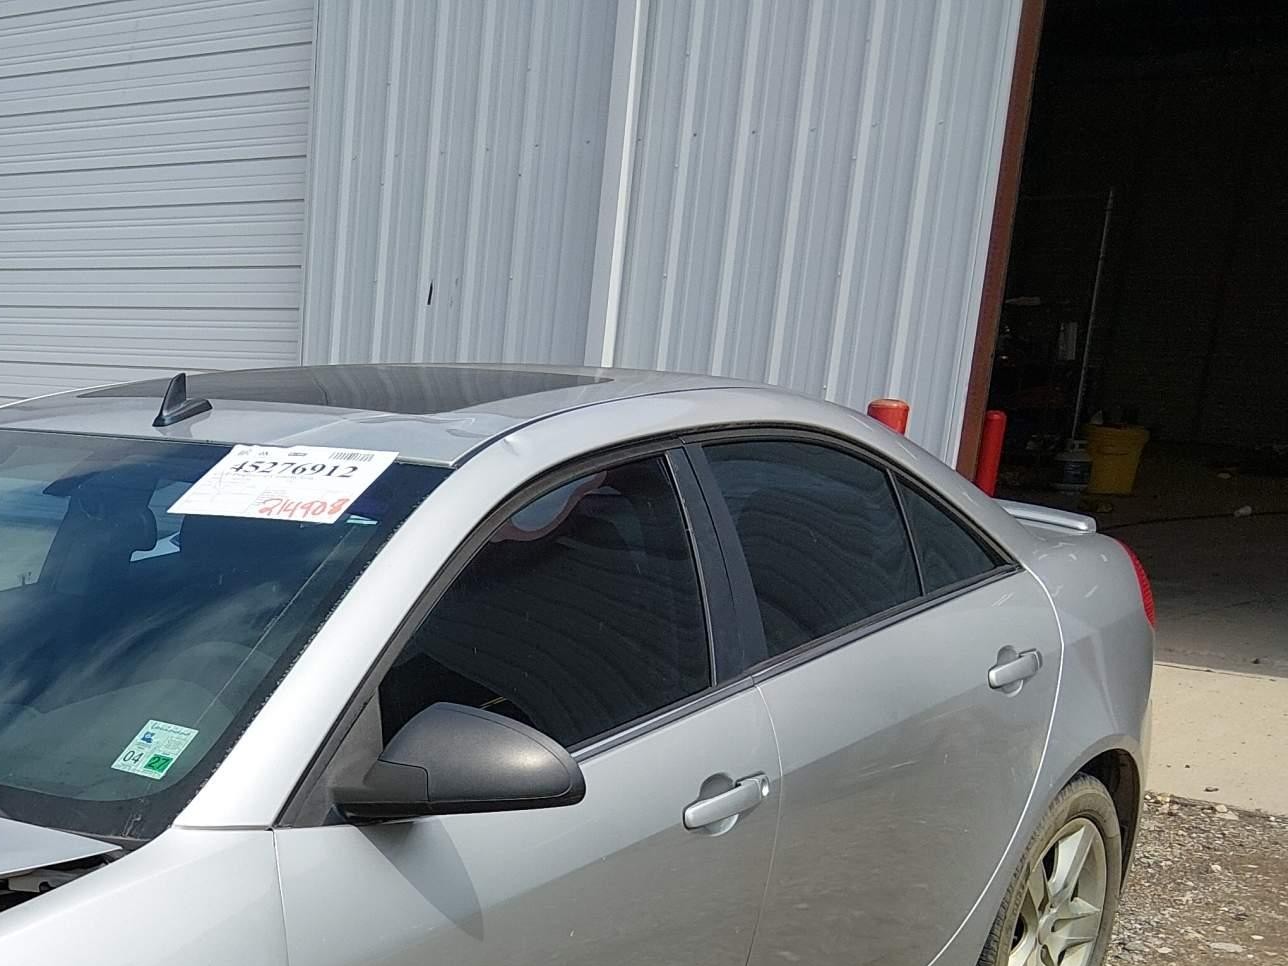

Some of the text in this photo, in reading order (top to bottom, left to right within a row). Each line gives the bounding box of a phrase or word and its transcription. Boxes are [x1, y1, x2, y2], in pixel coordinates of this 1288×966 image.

[230, 461, 359, 478] 45276912
[123, 750, 144, 764] 04
[148, 756, 170, 771] 27
